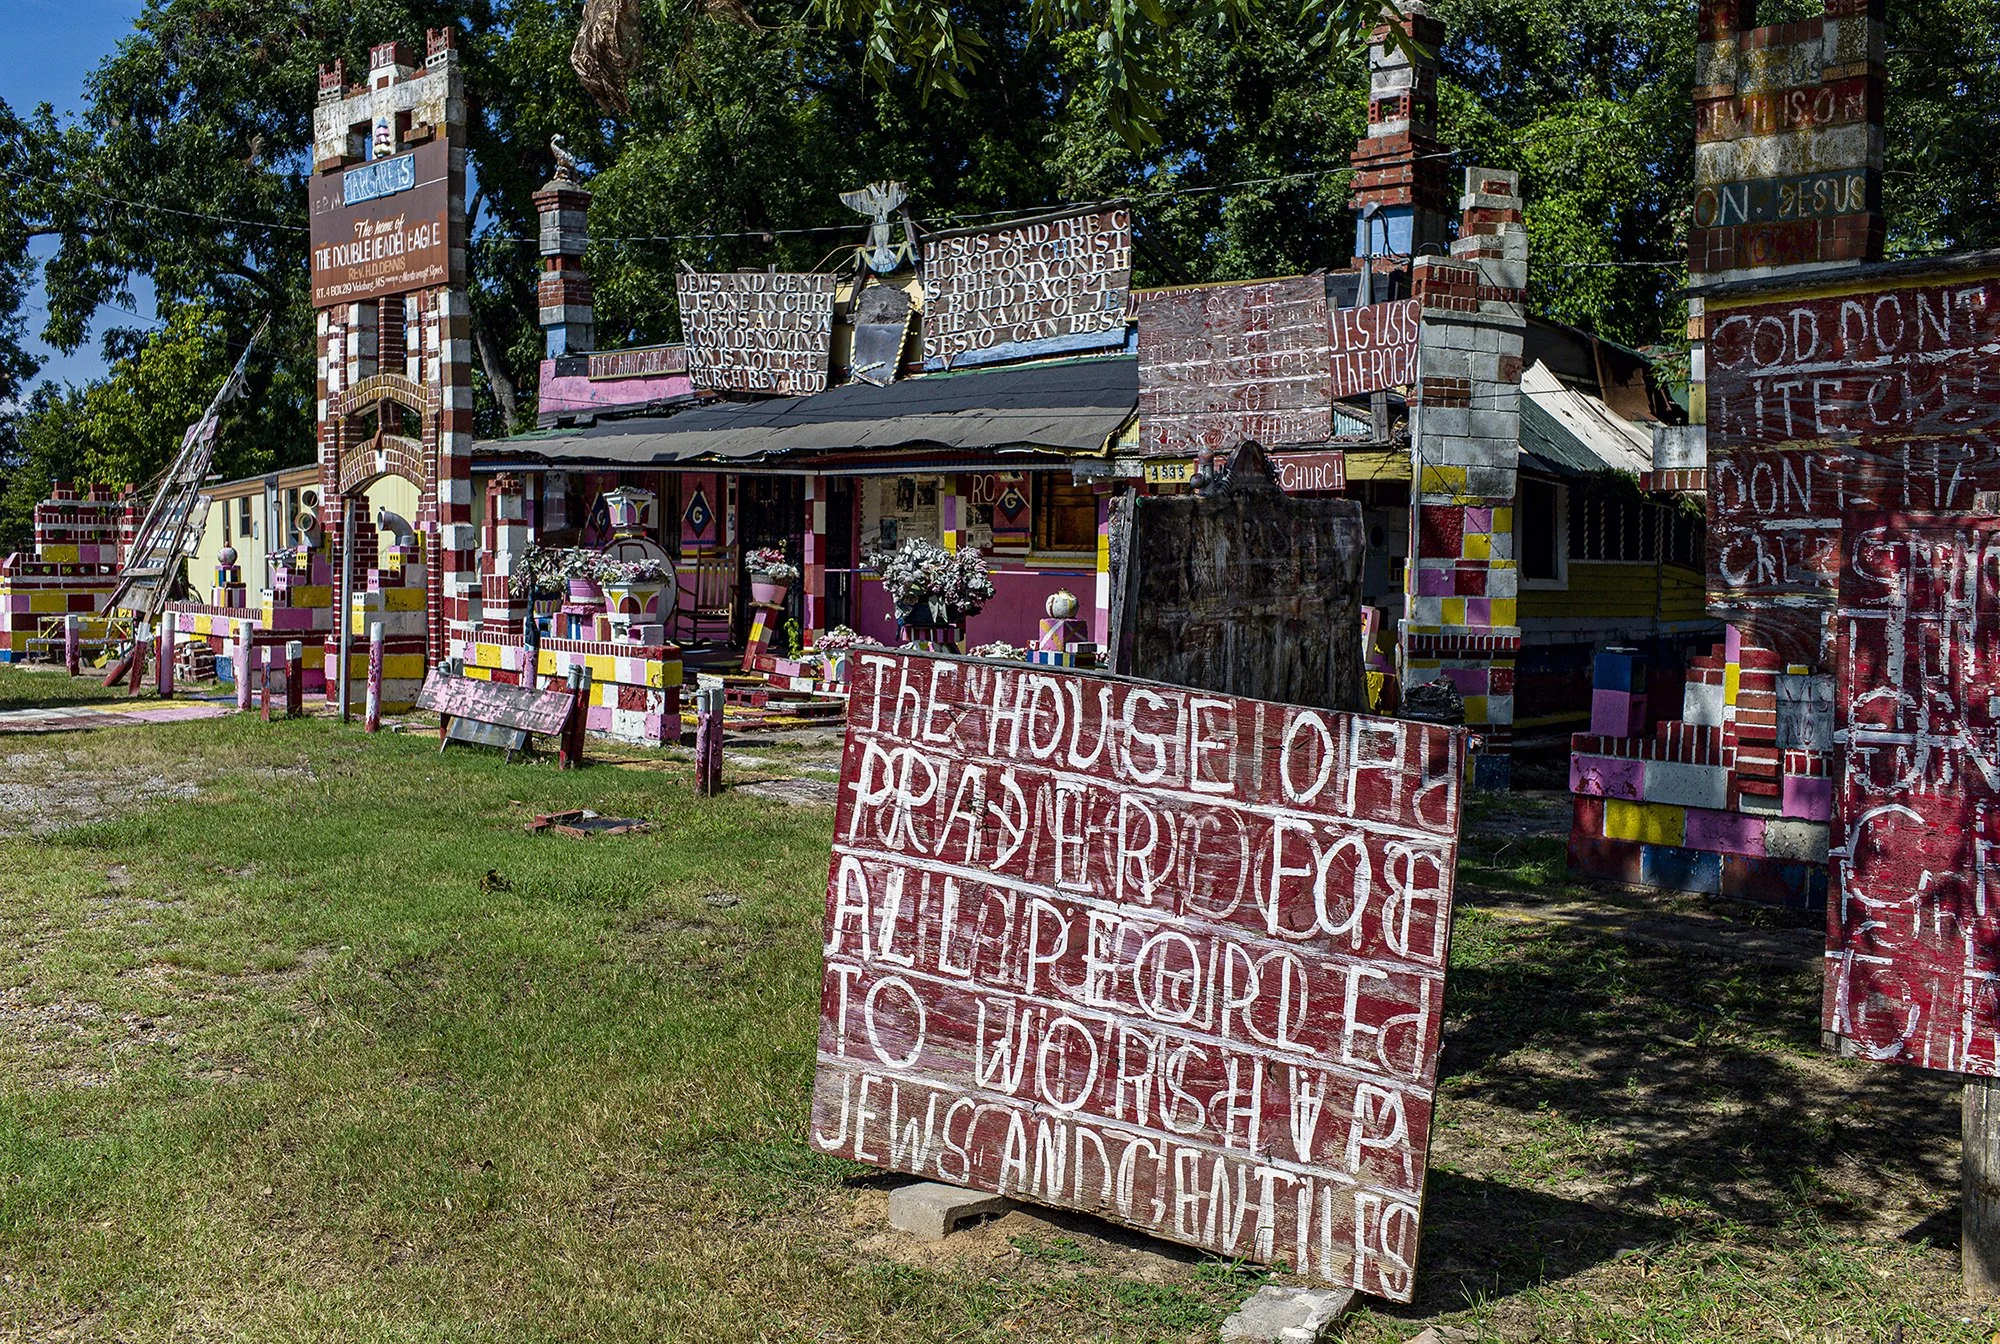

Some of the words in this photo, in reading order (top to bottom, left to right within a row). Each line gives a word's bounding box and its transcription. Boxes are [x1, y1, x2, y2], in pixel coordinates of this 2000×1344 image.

[354, 218, 374, 239] The
[373, 220, 393, 235] home
[394, 213, 406, 235] of
[926, 233, 990, 262] JESUS
[999, 223, 1050, 250] SAID
[1052, 213, 1101, 240] THE
[1111, 210, 1127, 230] C
[315, 248, 331, 271] THE
[333, 239, 371, 267] DOUBLE
[371, 231, 407, 261] HEADED
[407, 222, 441, 252] EAGLE
[924, 252, 996, 280] HURCH
[1002, 246, 1032, 270] OF
[1038, 231, 1129, 262] CHRIST
[375, 276, 386, 287] MS
[379, 256, 406, 276] DENNIS
[680, 273, 722, 293] JEWS
[728, 273, 765, 293] AND
[772, 273, 824, 293] GENT
[924, 280, 942, 300] IS
[949, 268, 994, 296] THE
[999, 260, 1057, 289] ONLY
[1058, 252, 1107, 279] ONE
[1113, 249, 1129, 270] H
[695, 292, 712, 312] IS
[715, 292, 750, 312] ONE
[757, 292, 779, 313] IN
[784, 292, 834, 314] CHRI
[924, 299, 937, 318] E
[948, 287, 1016, 315] BUILD
[1024, 272, 1112, 304] EXCEPT
[976, 301, 1042, 328] NAME
[1051, 297, 1081, 318] OF
[1090, 289, 1120, 312] JE
[681, 311, 698, 330] ST
[701, 311, 750, 330] JESUS
[754, 311, 791, 332] ALL
[795, 313, 813, 332] IS
[1012, 319, 1059, 343] CAN
[684, 328, 731, 348] ELCOM
[734, 329, 825, 351] DENOMINA
[719, 348, 735, 367] IS
[740, 350, 776, 371] NOT
[782, 351, 819, 373] THE
[1370, 343, 1418, 392] ROCK
[689, 368, 747, 390] CHURCH
[748, 370, 781, 390] REV
[1281, 460, 1343, 489] CHURCH
[986, 667, 1236, 795] HOUSE
[1279, 710, 1400, 818] OF
[825, 855, 971, 976] ALL
[827, 962, 926, 1068] TO
[974, 997, 1403, 1175] WORSHIP
[997, 1108, 1113, 1203] AND
[1115, 1137, 1421, 1303] GENTILES
